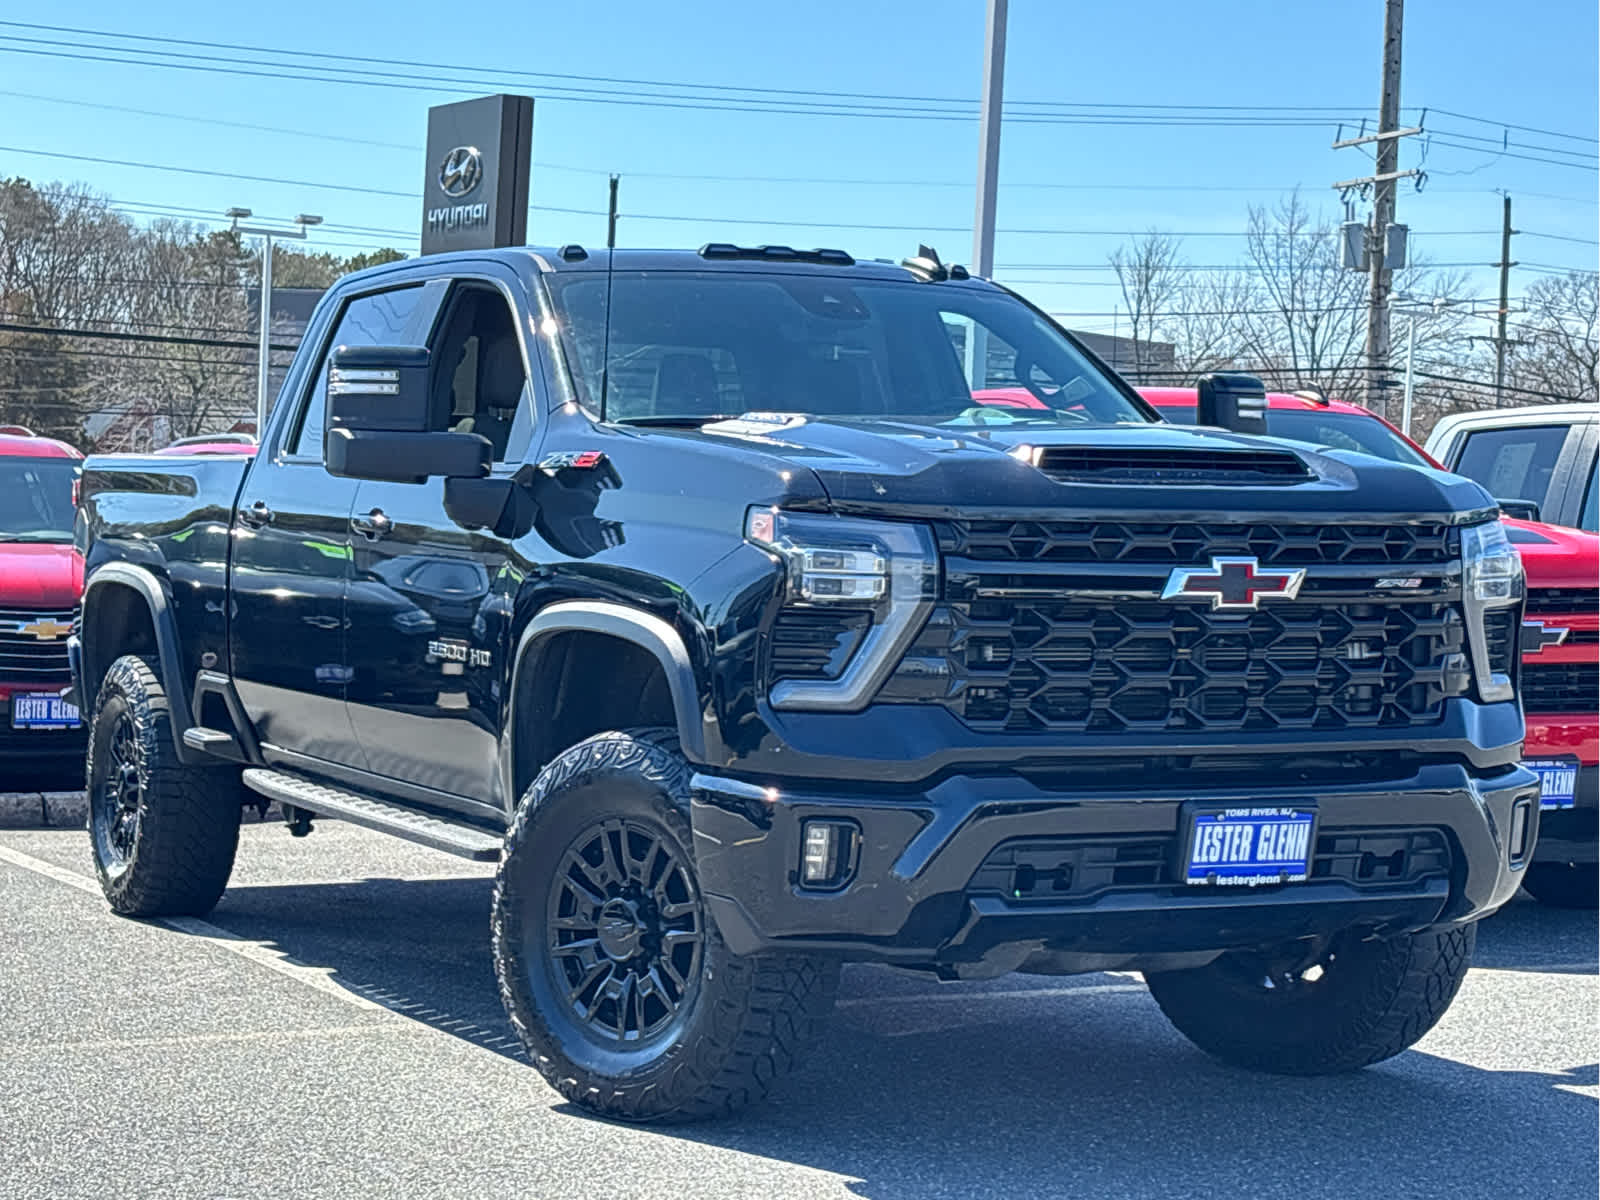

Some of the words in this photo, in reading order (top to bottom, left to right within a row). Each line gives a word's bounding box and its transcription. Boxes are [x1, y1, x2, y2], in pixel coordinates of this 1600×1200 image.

[428, 203, 488, 229] HYUNDAI
[539, 451, 602, 468] ZR2
[428, 641, 468, 661] 2500
[469, 648, 492, 667] HD
[15, 699, 48, 719] LESTER
[51, 699, 80, 719] GLENN
[1541, 771, 1576, 795] GLENN
[1225, 808, 1250, 817] TOMS
[1280, 808, 1292, 816] NJ
[1192, 825, 1254, 863] LESTER
[1256, 823, 1310, 861] GLENN
